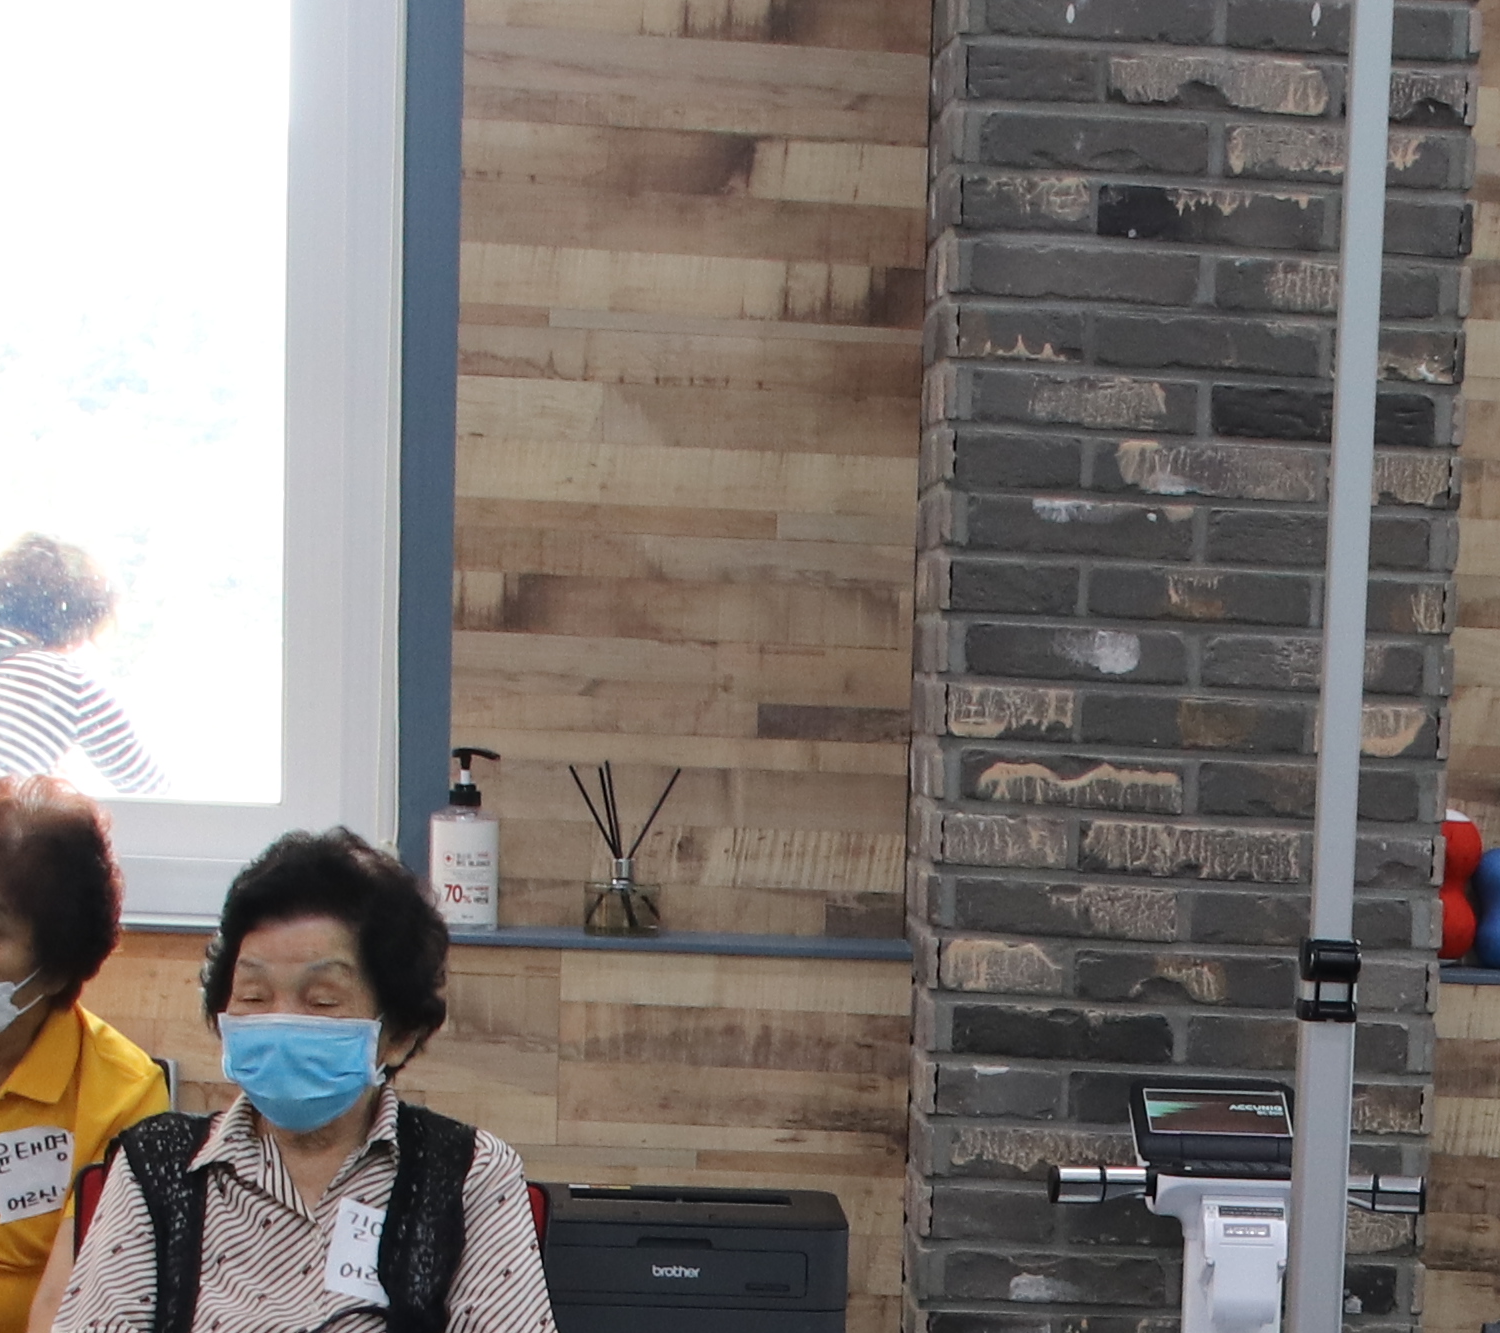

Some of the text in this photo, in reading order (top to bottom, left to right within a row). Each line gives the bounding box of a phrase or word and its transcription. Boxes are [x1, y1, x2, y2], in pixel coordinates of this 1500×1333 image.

[7, 1185, 58, 1211] 어르신
[339, 1262, 379, 1287] 어르
[651, 1265, 700, 1278] brother
